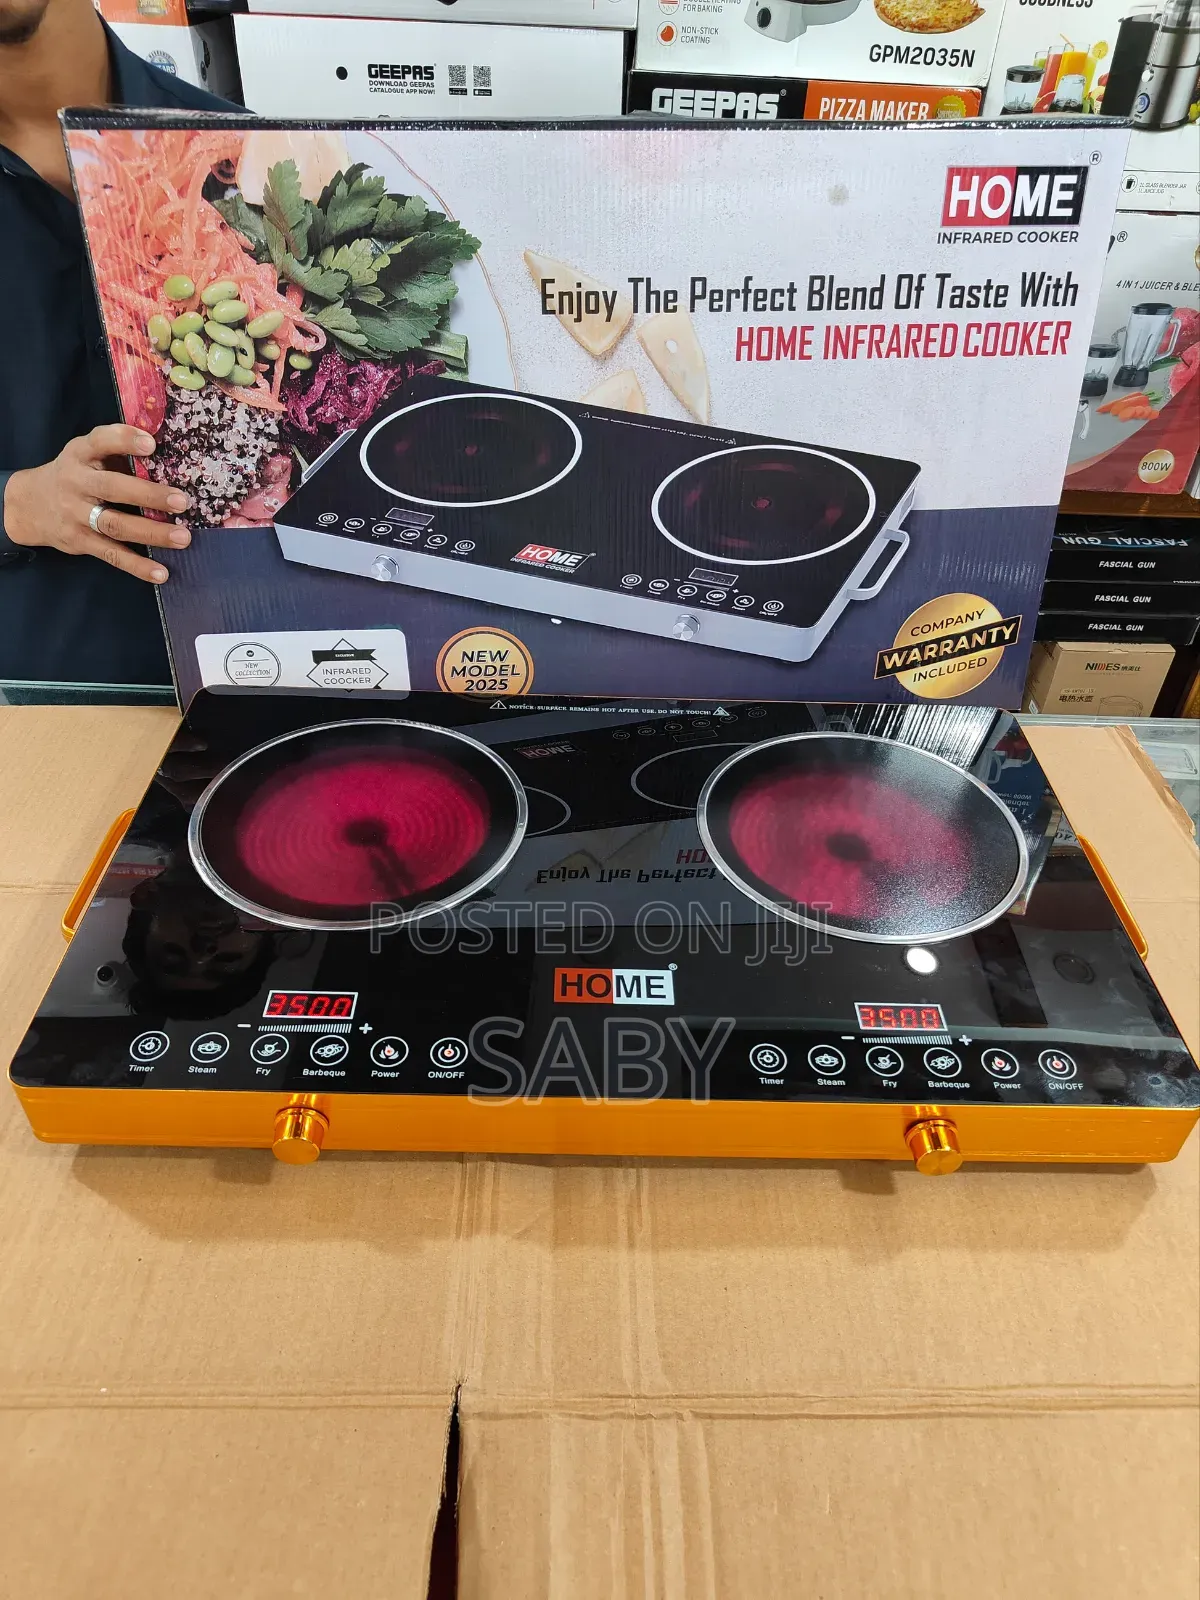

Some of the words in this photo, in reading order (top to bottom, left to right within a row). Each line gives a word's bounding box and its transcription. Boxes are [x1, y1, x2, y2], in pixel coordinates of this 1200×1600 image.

[682, 3, 697, 12] FOR
[698, 4, 723, 13] BAKING
[681, 26, 719, 35] NON-STICK
[680, 36, 710, 44] COATING
[869, 44, 976, 68] GPM2035N
[368, 64, 434, 80] GEEPAS
[651, 87, 780, 120] GEEPAS
[819, 97, 866, 120] PIZZA
[870, 99, 930, 121] MAKER
[948, 174, 1078, 218] HOME
[937, 231, 1013, 244] INFRARED
[1017, 231, 1079, 243] COOKER
[1116, 280, 1122, 288] 4
[1122, 280, 1133, 289] IN
[1134, 280, 1139, 289] 1
[1140, 280, 1173, 290] JUICER
[1174, 282, 1180, 291] &
[540, 278, 618, 323] Enjoy
[627, 277, 678, 314] The
[690, 276, 798, 312] Perfect
[806, 274, 886, 311] Blend
[894, 273, 926, 310] Of
[935, 272, 1010, 309] Taste
[1020, 270, 1078, 308] With
[735, 325, 814, 362] HOME
[822, 323, 958, 360] INFRARED
[962, 320, 1072, 358] COOKER
[1140, 461, 1172, 472] 800W
[520, 546, 583, 566] HOME
[510, 557, 544, 568] INFRARED
[545, 564, 575, 574] COOKER
[1094, 594, 1130, 603] FASCIAL
[1133, 595, 1151, 603] GUN
[910, 608, 985, 637] COMPANY
[1088, 623, 1122, 631] FASCIAL
[1126, 624, 1144, 632] GUN
[882, 622, 1016, 670] WARRANTY
[460, 650, 509, 662] NEW
[322, 667, 371, 676] INFRARED
[450, 664, 521, 678] MODEL
[912, 656, 988, 682] INCLUDED
[324, 677, 371, 685] COOCKER
[464, 679, 508, 691] 2025
[560, 973, 666, 999] HOME
[128, 1064, 154, 1073] Timer
[188, 1065, 217, 1074] Steam
[255, 1067, 271, 1077] Fry
[302, 1068, 346, 1078] Barbeque
[370, 1070, 400, 1079] Power
[428, 1071, 465, 1079] ON/OFF
[758, 1077, 784, 1085] Timer
[817, 1078, 846, 1086] Steam
[882, 1080, 898, 1089] Fry
[927, 1081, 970, 1090] Barbeque
[993, 1082, 1022, 1090] Power
[1048, 1082, 1084, 1091] ON/OFF
